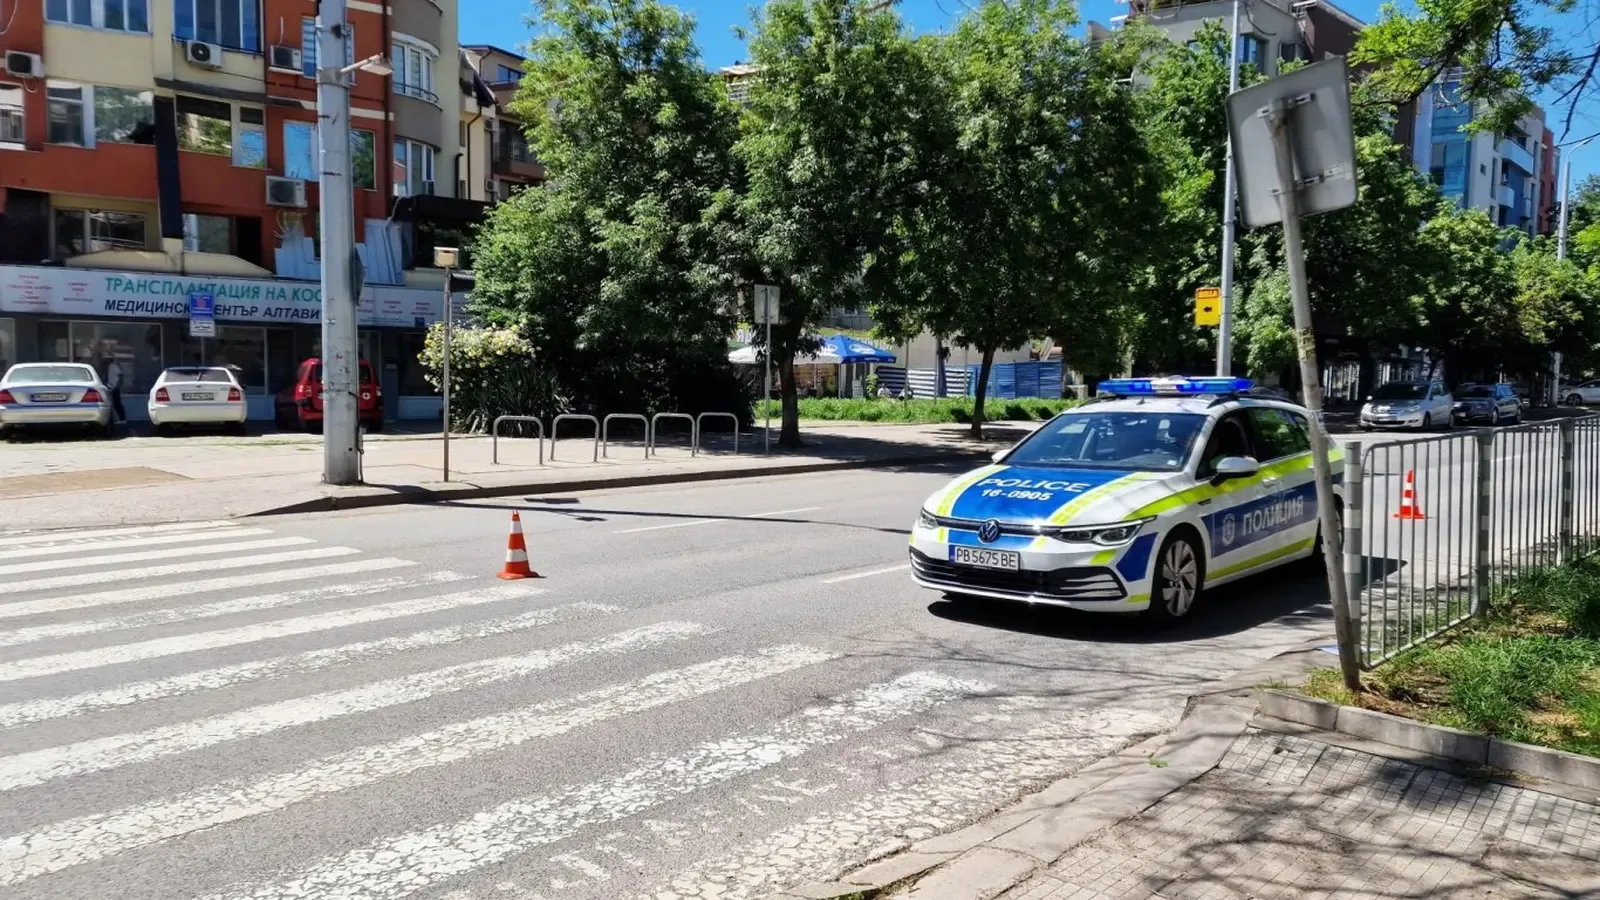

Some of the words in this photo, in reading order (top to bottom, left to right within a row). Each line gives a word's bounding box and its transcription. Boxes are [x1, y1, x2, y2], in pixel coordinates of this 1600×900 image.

[266, 287, 286, 301] НА
[292, 288, 322, 303] КОС
[104, 299, 191, 315] МЕДИЦИНСК
[214, 305, 258, 317] ЕНТЪР
[262, 307, 320, 319] АЛТАВИ
[977, 479, 1092, 493] POLICE
[981, 488, 1055, 501] 16-0905
[1243, 495, 1304, 536] ПОЛИЦИЯ
[972, 552, 999, 565] 5675
